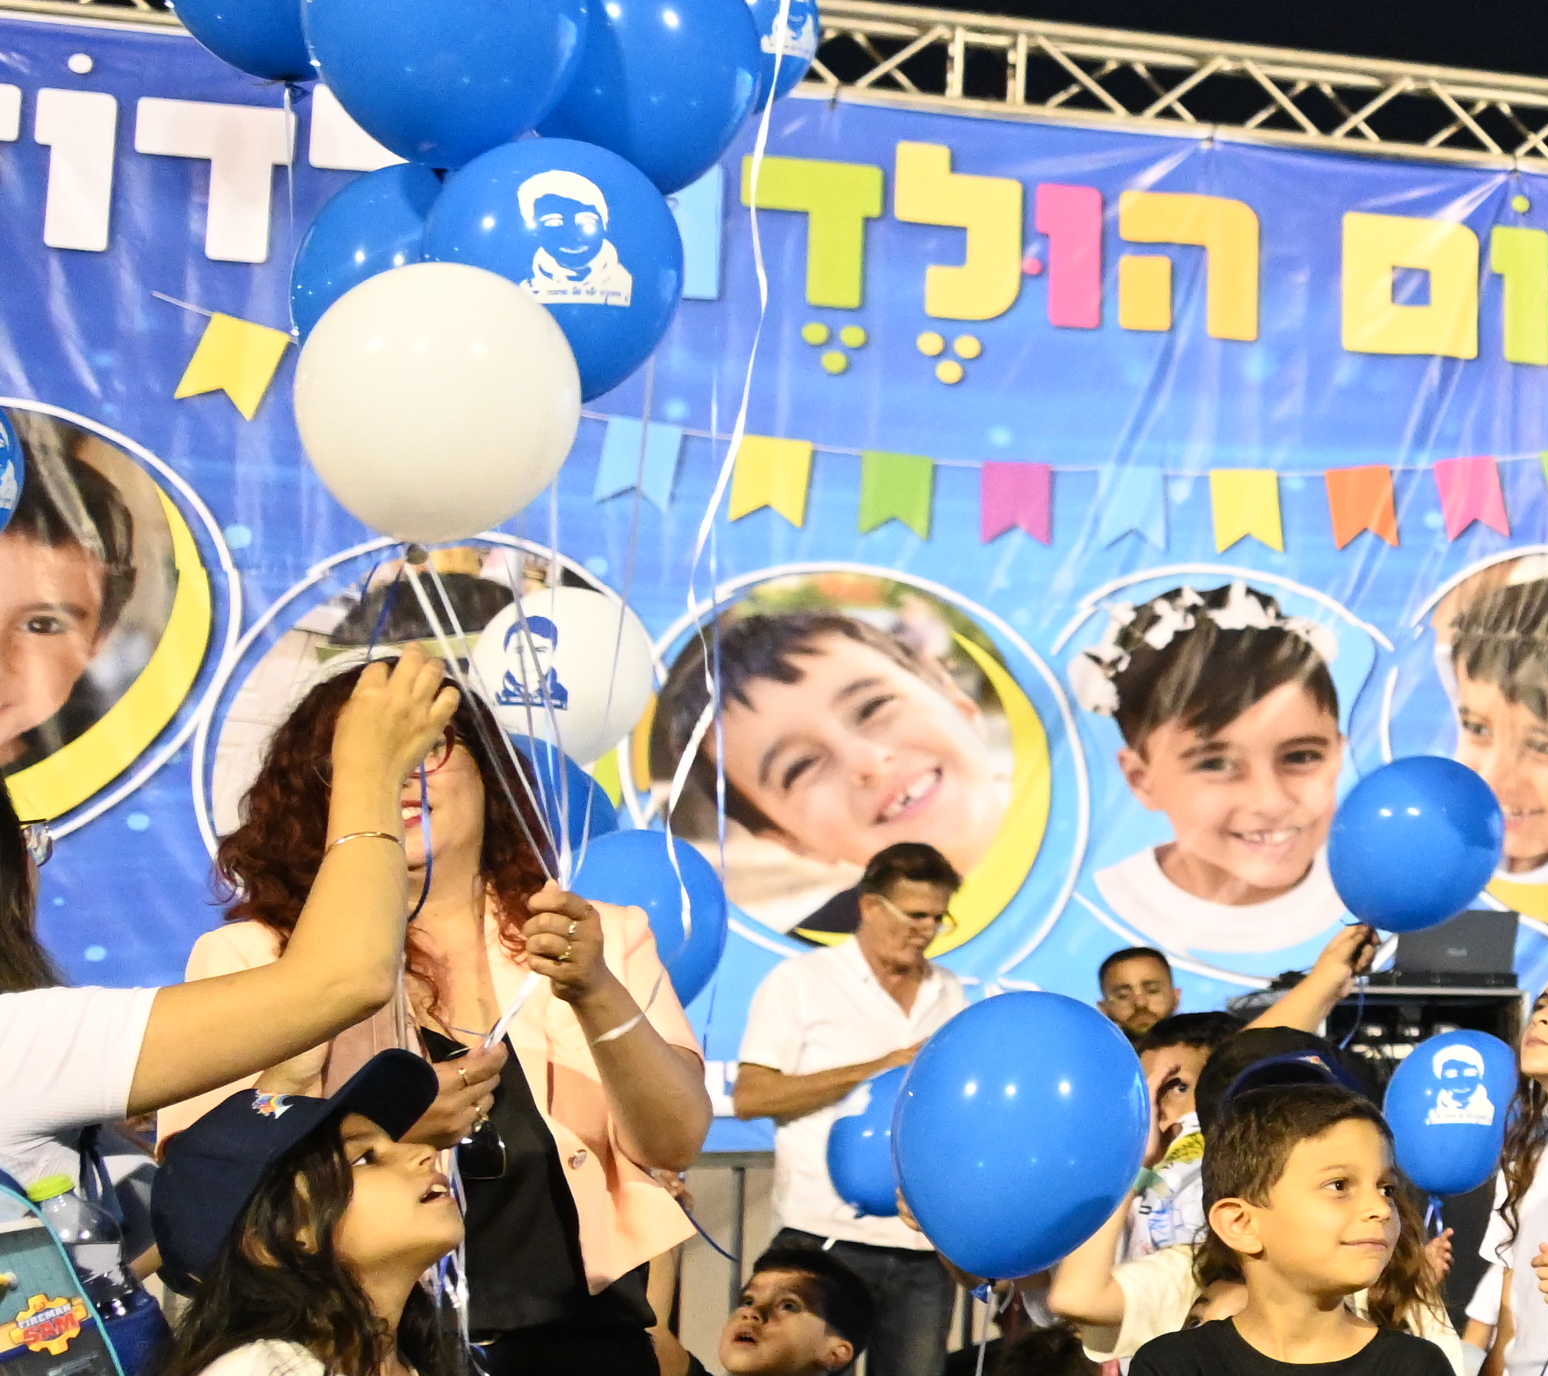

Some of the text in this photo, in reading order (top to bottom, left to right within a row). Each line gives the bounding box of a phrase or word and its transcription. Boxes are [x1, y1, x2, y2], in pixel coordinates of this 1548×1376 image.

[668, 140, 1260, 385] הוּלֶדֶ
[17, 1303, 72, 1330] FIREMAN
[23, 1312, 80, 1346] SAM
